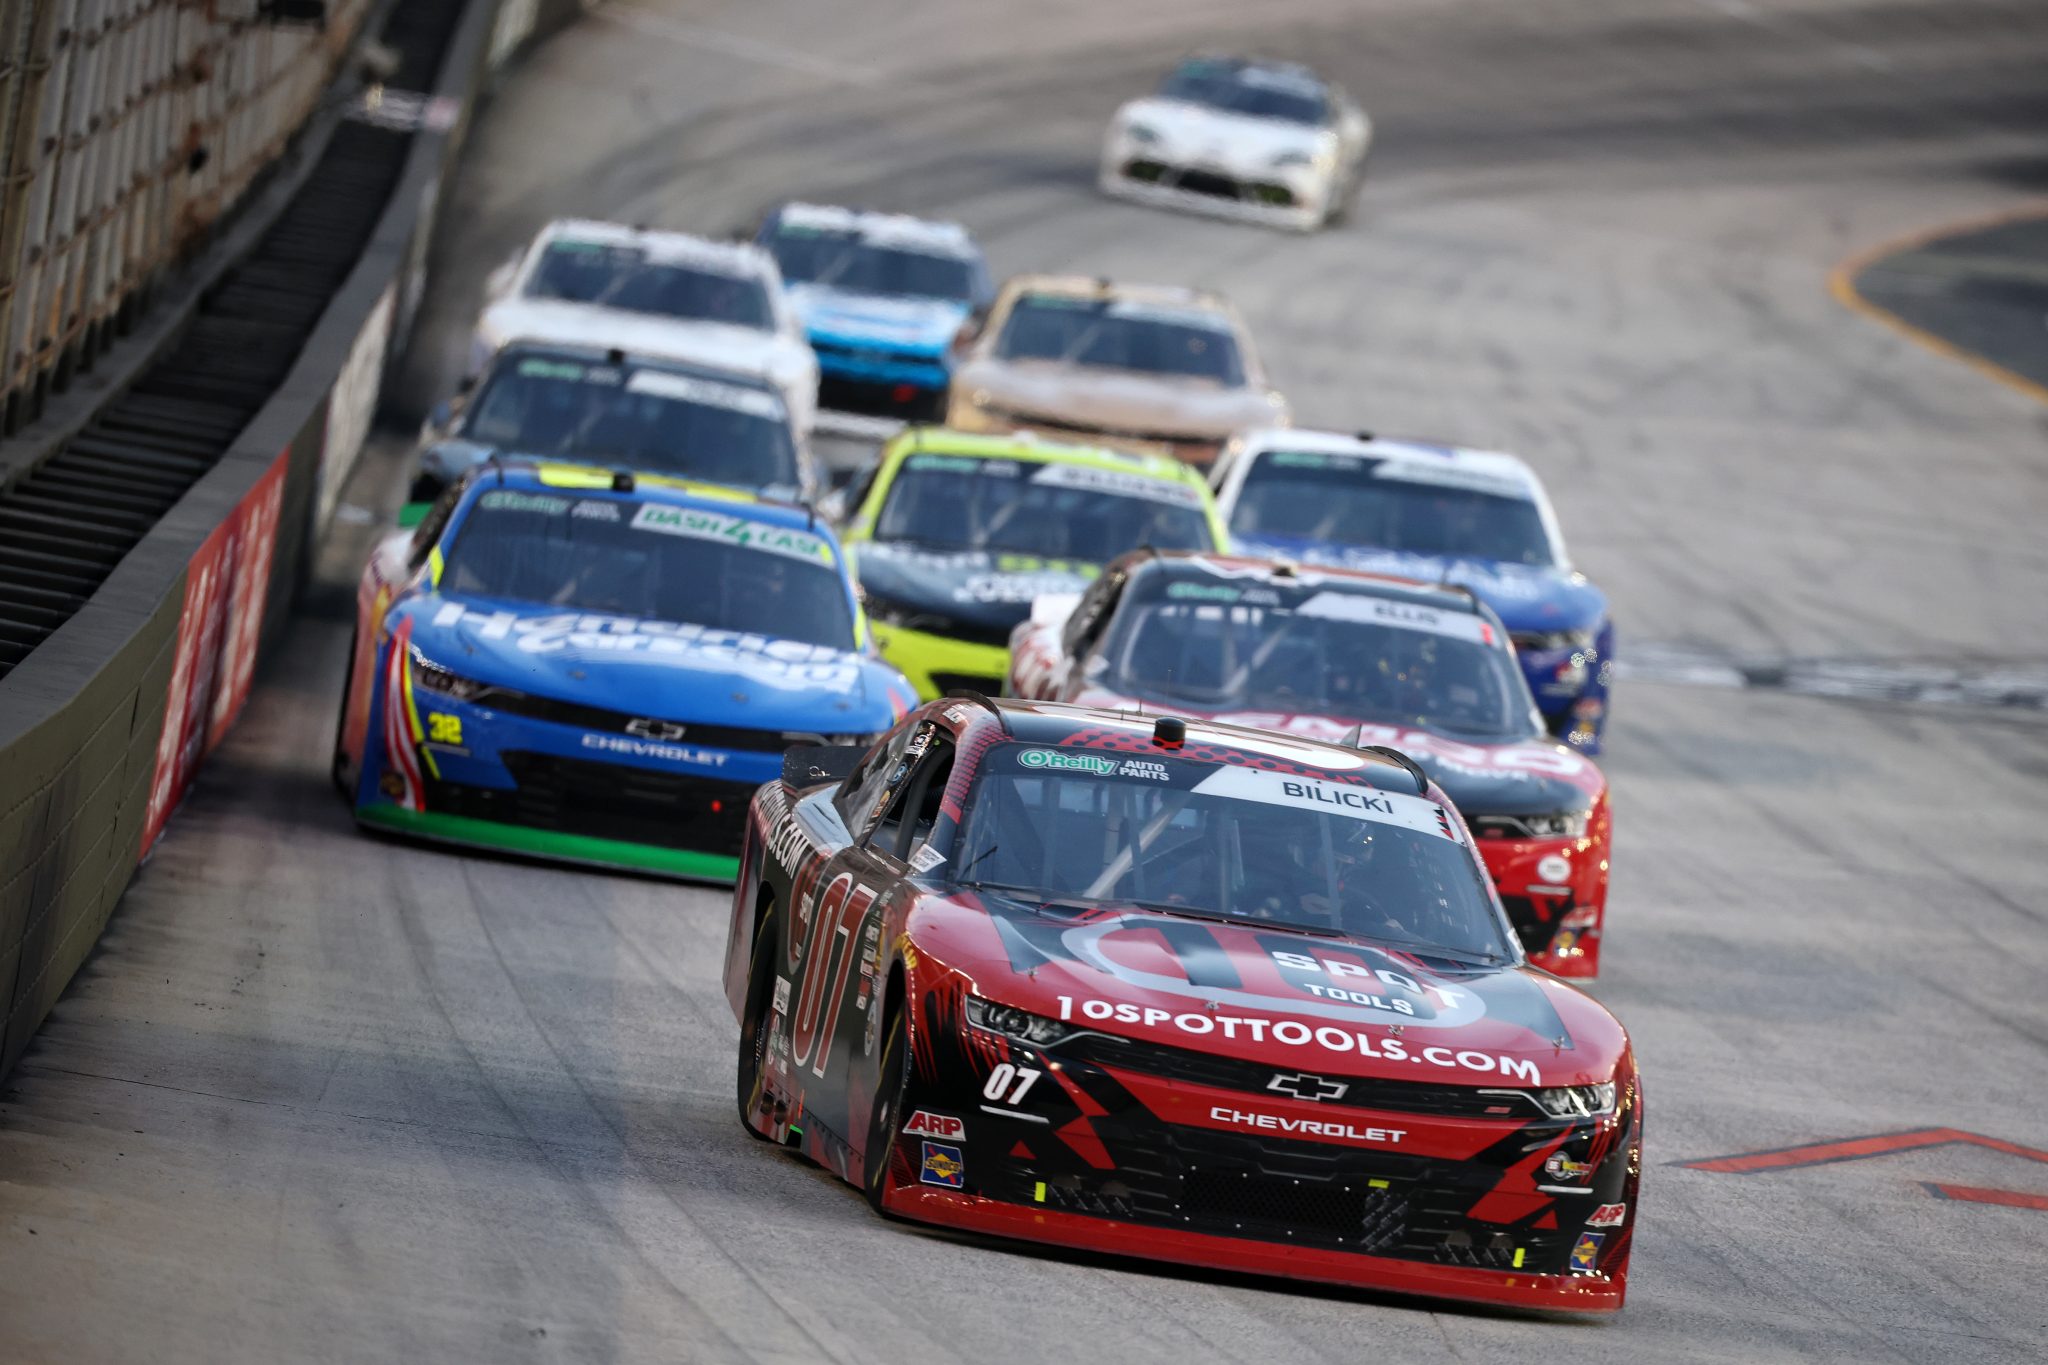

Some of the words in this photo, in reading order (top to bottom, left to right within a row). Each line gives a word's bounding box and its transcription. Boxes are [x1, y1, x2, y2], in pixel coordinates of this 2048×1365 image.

[643, 504, 721, 533] DASH
[724, 519, 753, 547] 4
[1374, 602, 1440, 626] ELLIS
[428, 711, 463, 745] 32
[581, 733, 731, 768] CHEVROLET
[1019, 749, 1116, 775] O'Reilly
[1124, 759, 1166, 772] AUTO
[1118, 766, 1170, 781] PARTS
[1282, 781, 1394, 815] BILICKI
[792, 872, 879, 1079] 07
[1271, 949, 1466, 1009] SPOT
[1303, 982, 1416, 1016] TOOLS
[1056, 995, 1541, 1087] 10SPOTTOOLS.COM
[982, 1062, 1042, 1105] 07
[907, 1112, 962, 1136] ARP
[1209, 1106, 1408, 1143] CHEVROLET
